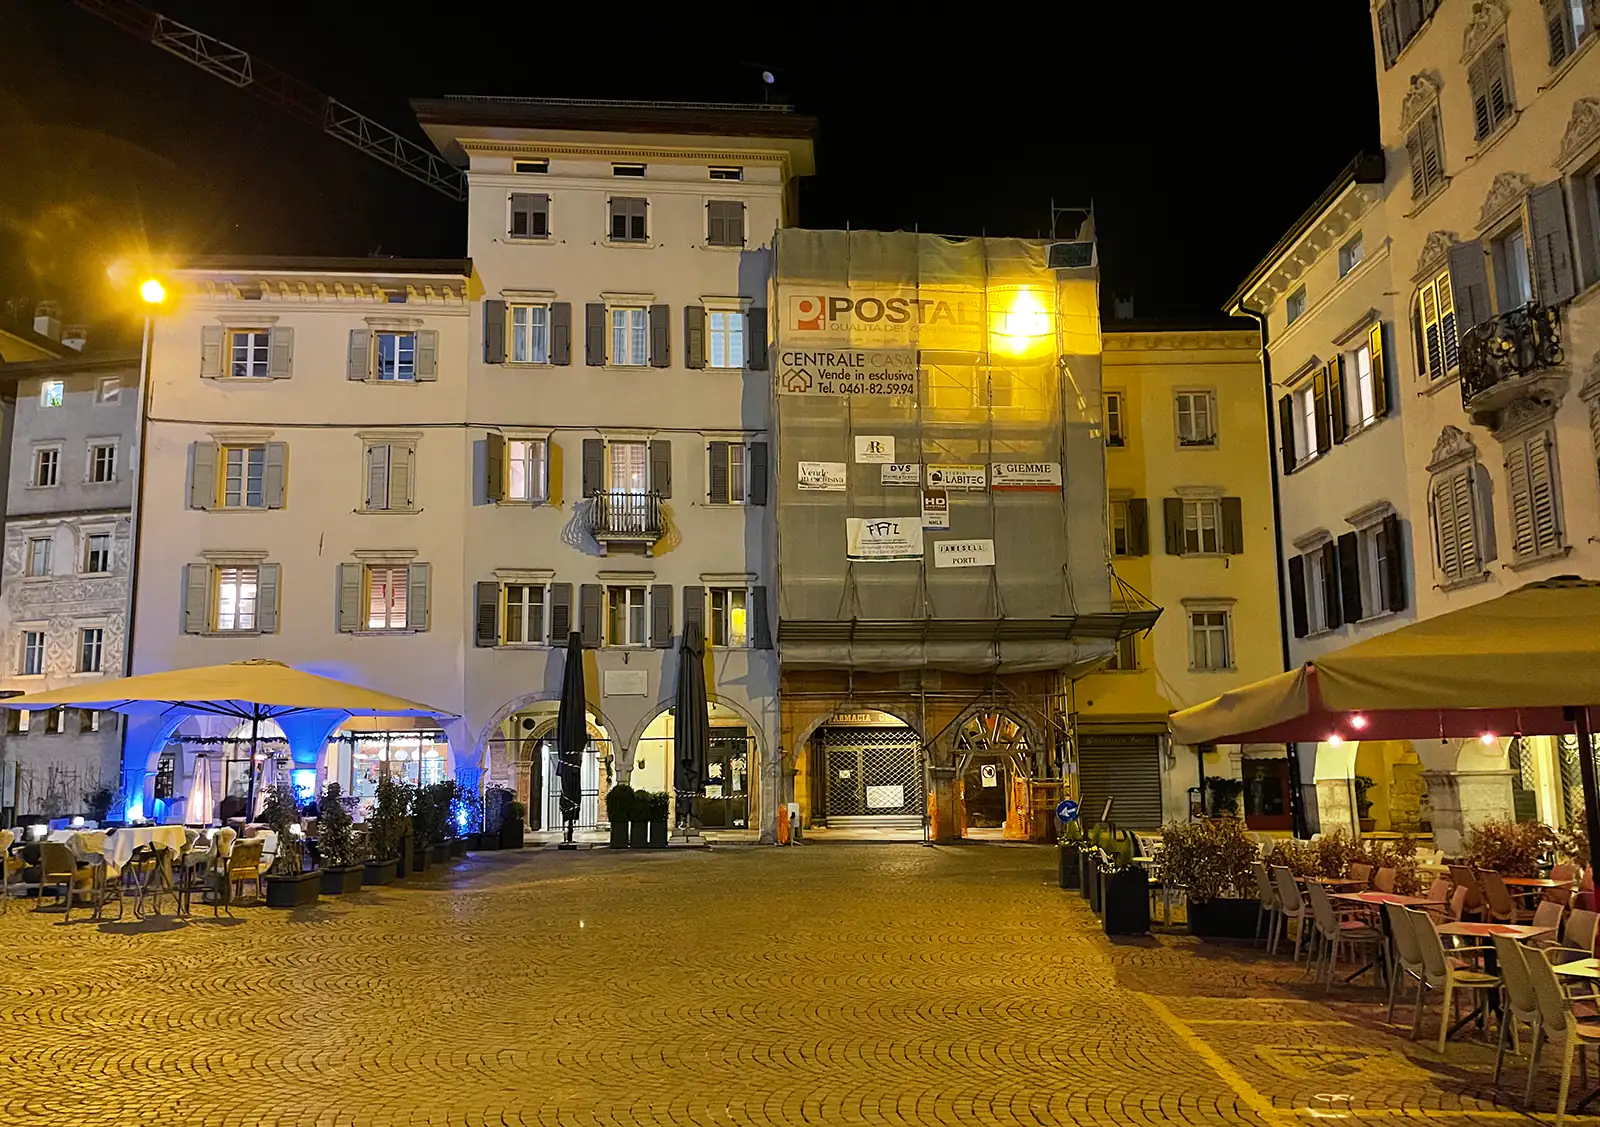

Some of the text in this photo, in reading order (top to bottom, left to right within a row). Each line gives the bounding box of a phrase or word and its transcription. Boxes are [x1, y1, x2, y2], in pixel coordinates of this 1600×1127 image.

[829, 297, 979, 325] POSTAL
[884, 323, 906, 332] DEL
[782, 352, 913, 366] CENTRALE CASA
[818, 368, 914, 381] Vende in esclusiva
[818, 382, 914, 394] Tel. 0461-82.59.94
[890, 464, 911, 472] DVS
[1006, 464, 1052, 473] GIEMME
[945, 475, 984, 484] LABITEC
